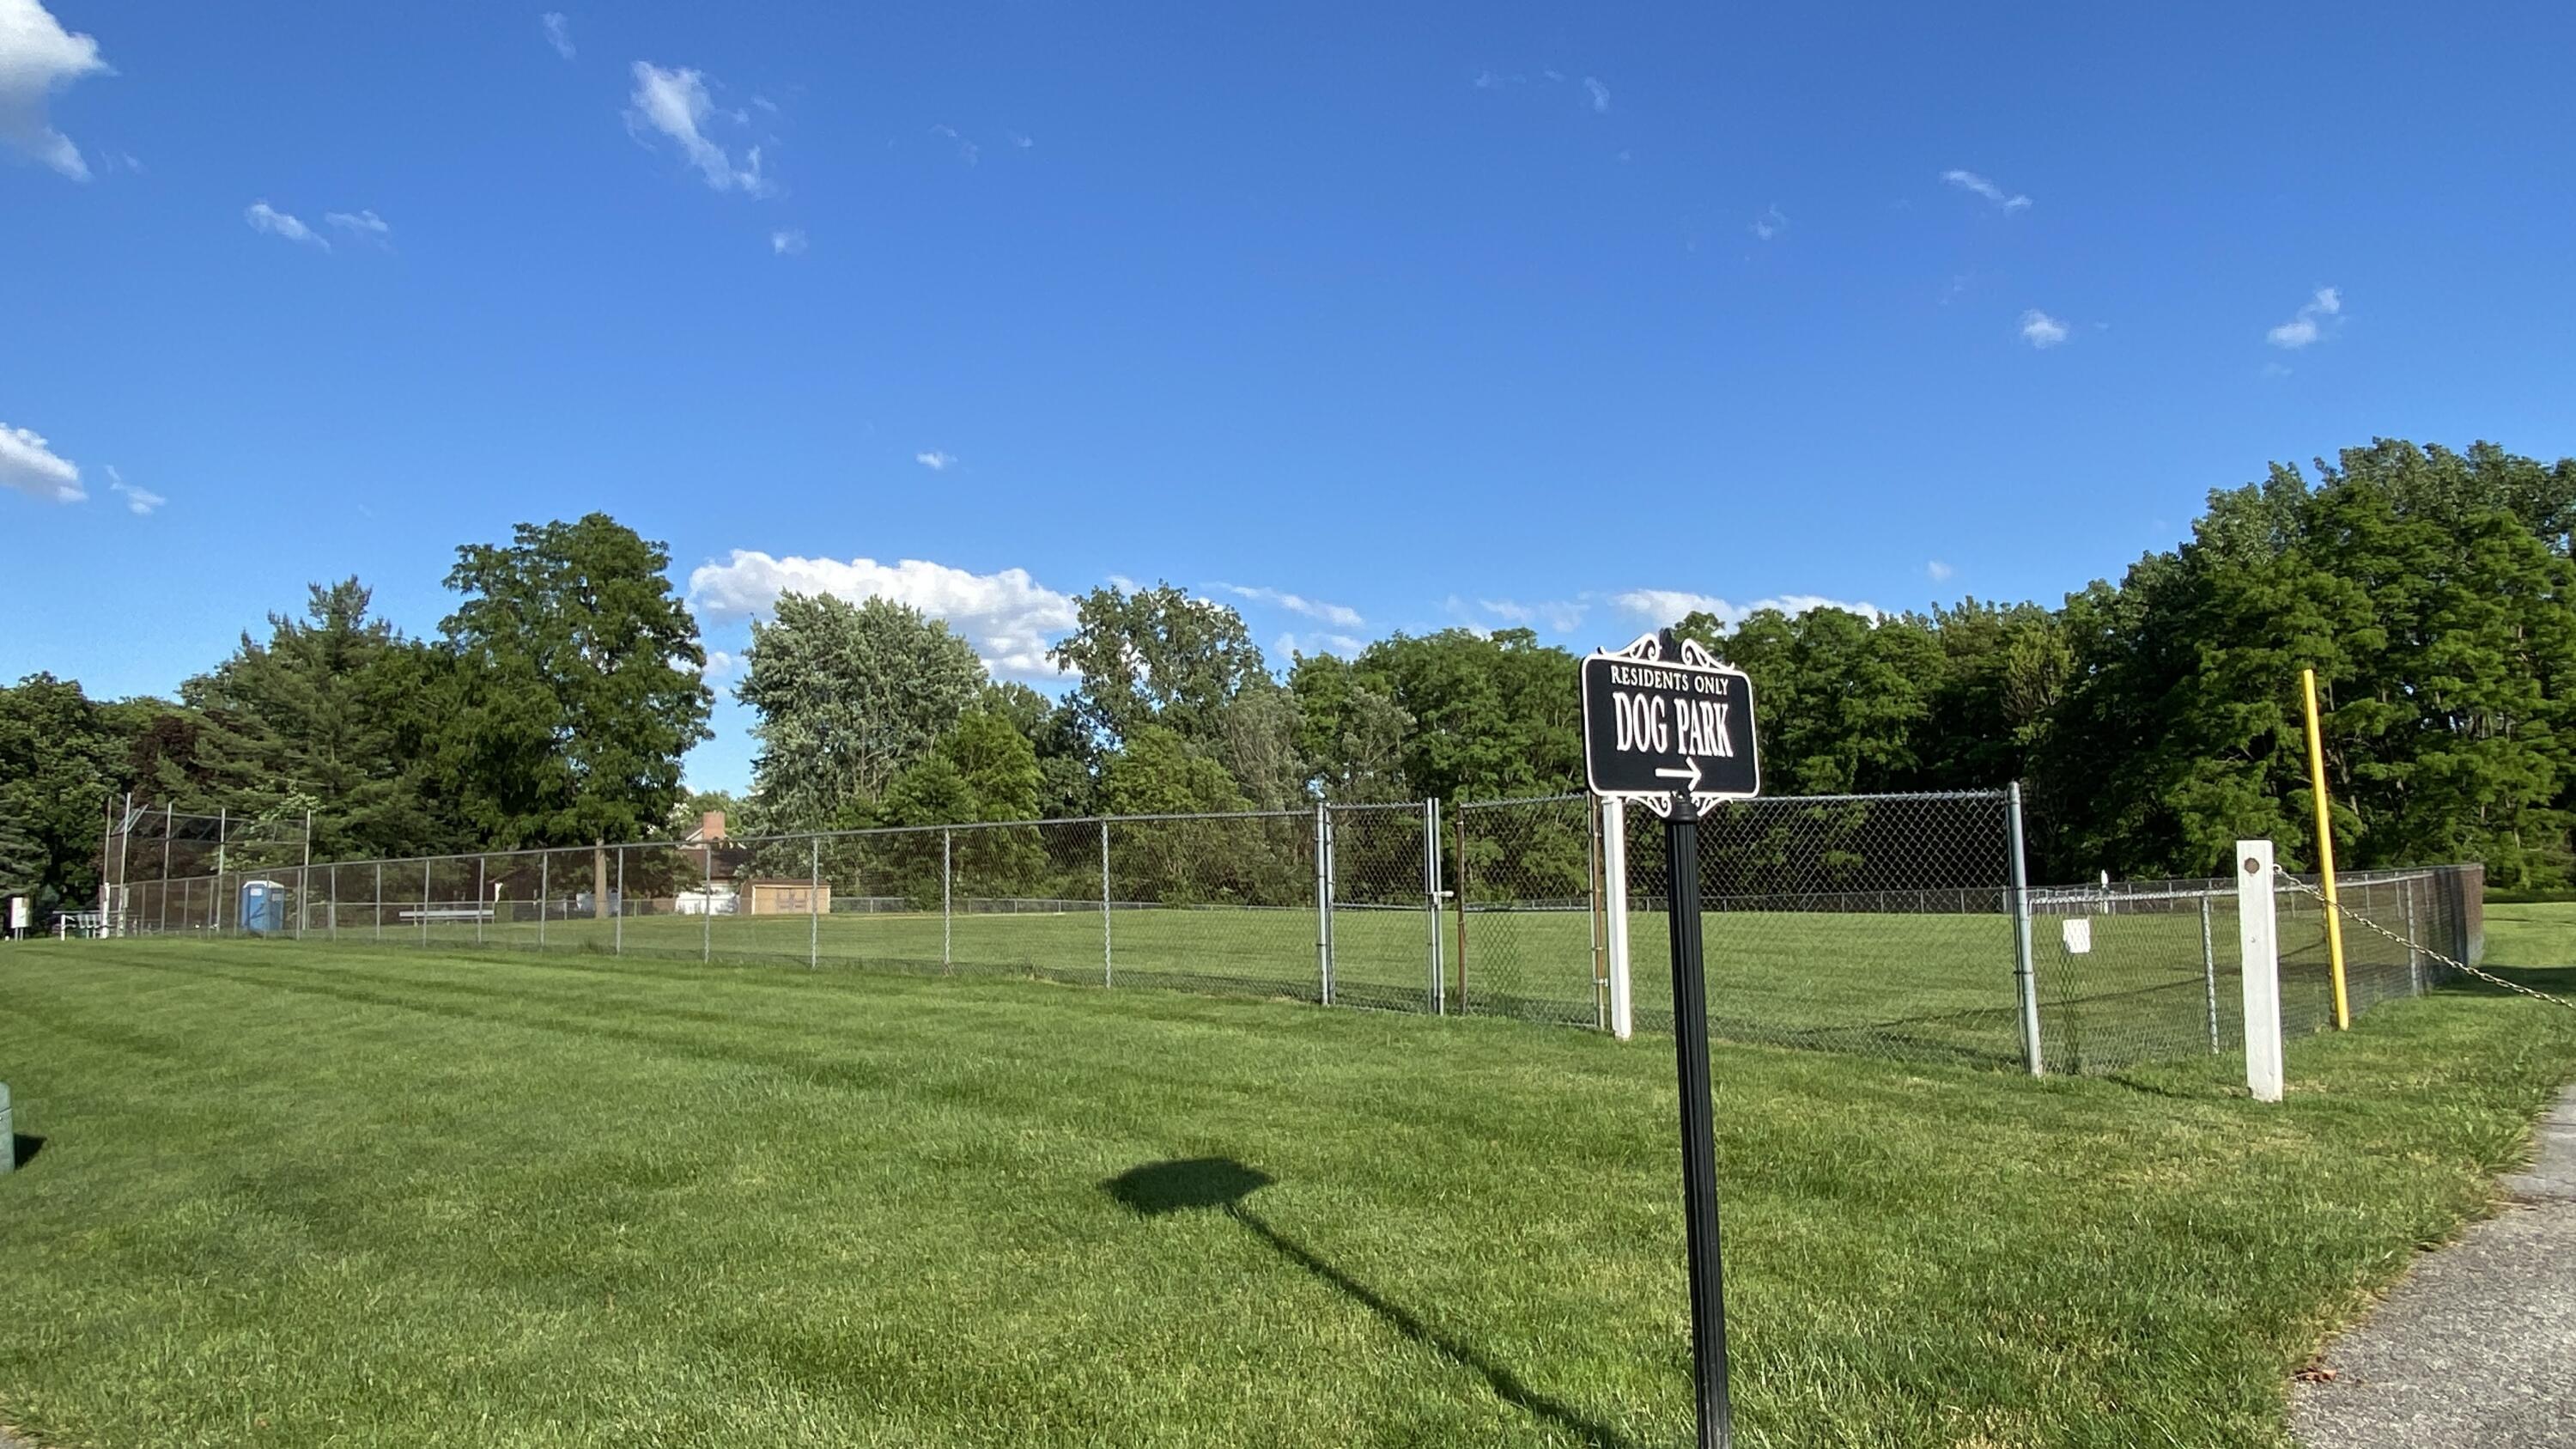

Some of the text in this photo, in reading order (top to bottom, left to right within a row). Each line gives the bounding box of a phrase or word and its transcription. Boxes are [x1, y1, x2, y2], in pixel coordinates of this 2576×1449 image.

[1610, 665, 1729, 696] RESIDENTS ONLY
[1612, 691, 1735, 758] DOG PARK
